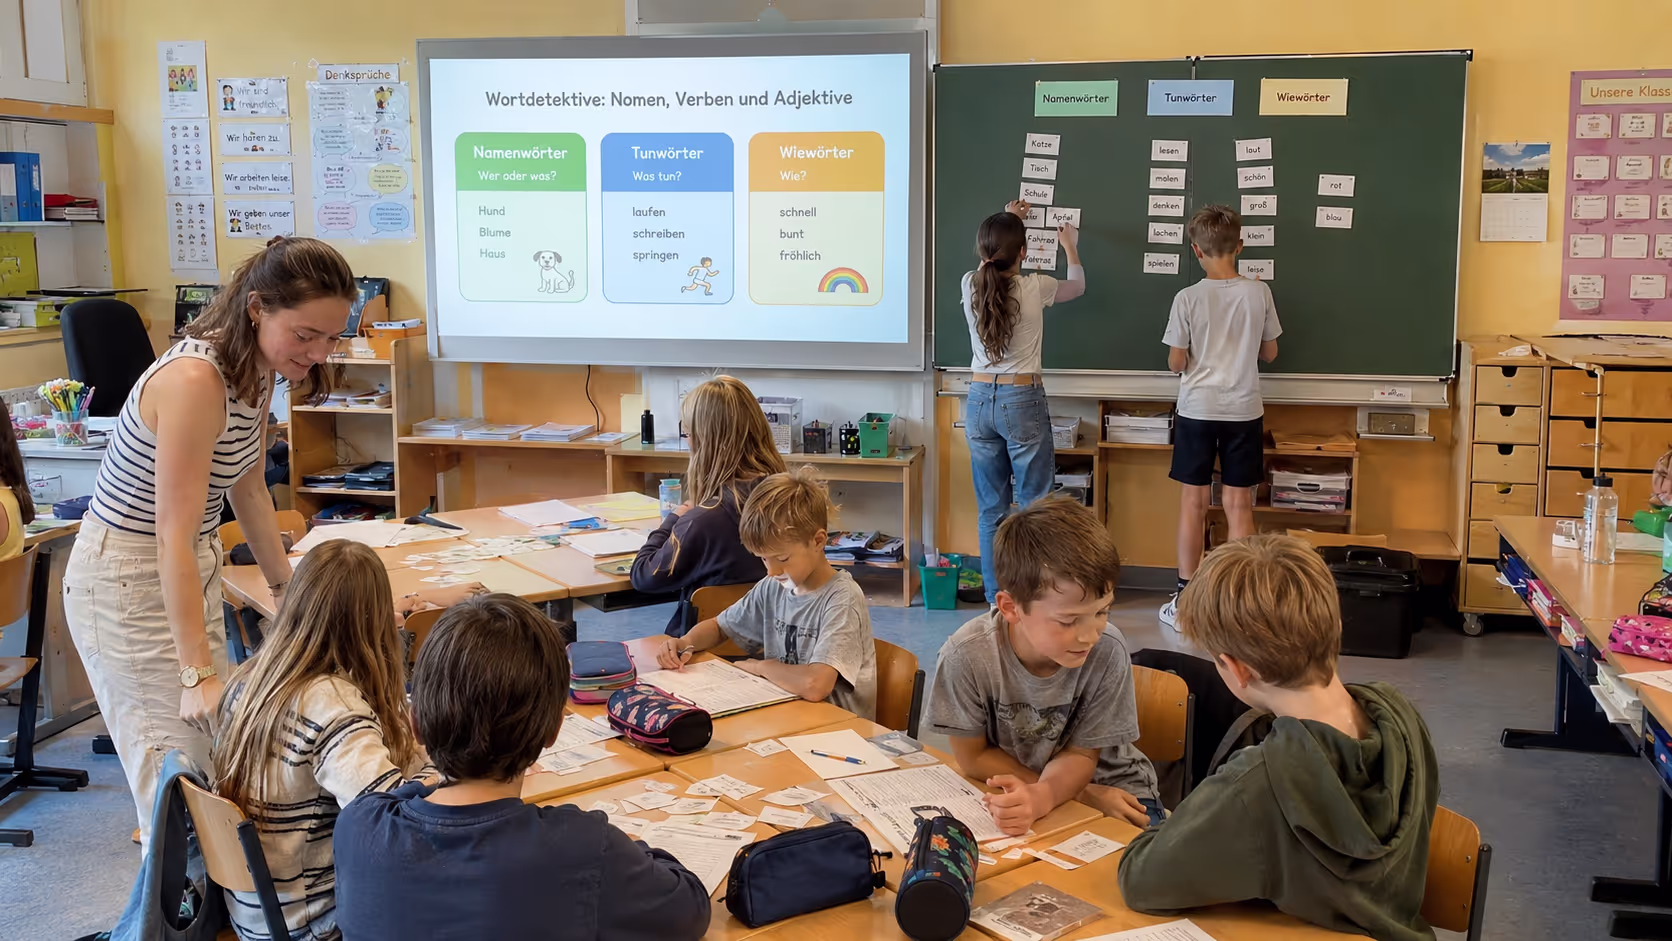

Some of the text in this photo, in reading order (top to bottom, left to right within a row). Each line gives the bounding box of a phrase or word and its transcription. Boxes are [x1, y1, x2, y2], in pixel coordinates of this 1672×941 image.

[325, 69, 391, 82] Denksprüche
[1590, 84, 1672, 98] Unsere Klass
[486, 90, 853, 109] Wortdetektive: Nomen, Verben und Adjektive
[1042, 93, 1109, 104] Namenwörter
[1165, 92, 1217, 103] Tunwörter
[1276, 92, 1331, 103] Wiewörter
[226, 134, 240, 142] Wir
[473, 146, 568, 160] Namenwörter
[632, 145, 704, 159] Tunwörter
[779, 145, 854, 159] Wiewörter
[1159, 146, 1180, 154] lesen
[1030, 163, 1049, 172] Tisch
[224, 173, 238, 182] Wir
[240, 173, 270, 182] arbeiten
[478, 170, 557, 181] Wer oder was?
[632, 170, 682, 182] Was tun?
[780, 170, 807, 181] Wie?
[1244, 173, 1266, 182] schön
[478, 206, 506, 216] Hund
[1152, 201, 1180, 210] denken
[1249, 201, 1268, 211] groß
[228, 209, 242, 217] Wir
[632, 206, 666, 217] laufen
[779, 207, 817, 217] schnell
[479, 227, 511, 237] Blume
[632, 228, 685, 239] schreiben
[779, 228, 804, 239] bunt
[1247, 232, 1265, 240] klein
[479, 248, 506, 258] Haus
[632, 250, 679, 262] springen
[779, 250, 822, 261] fröhlich
[1147, 259, 1175, 268] spielen
[1247, 265, 1265, 273] leise
